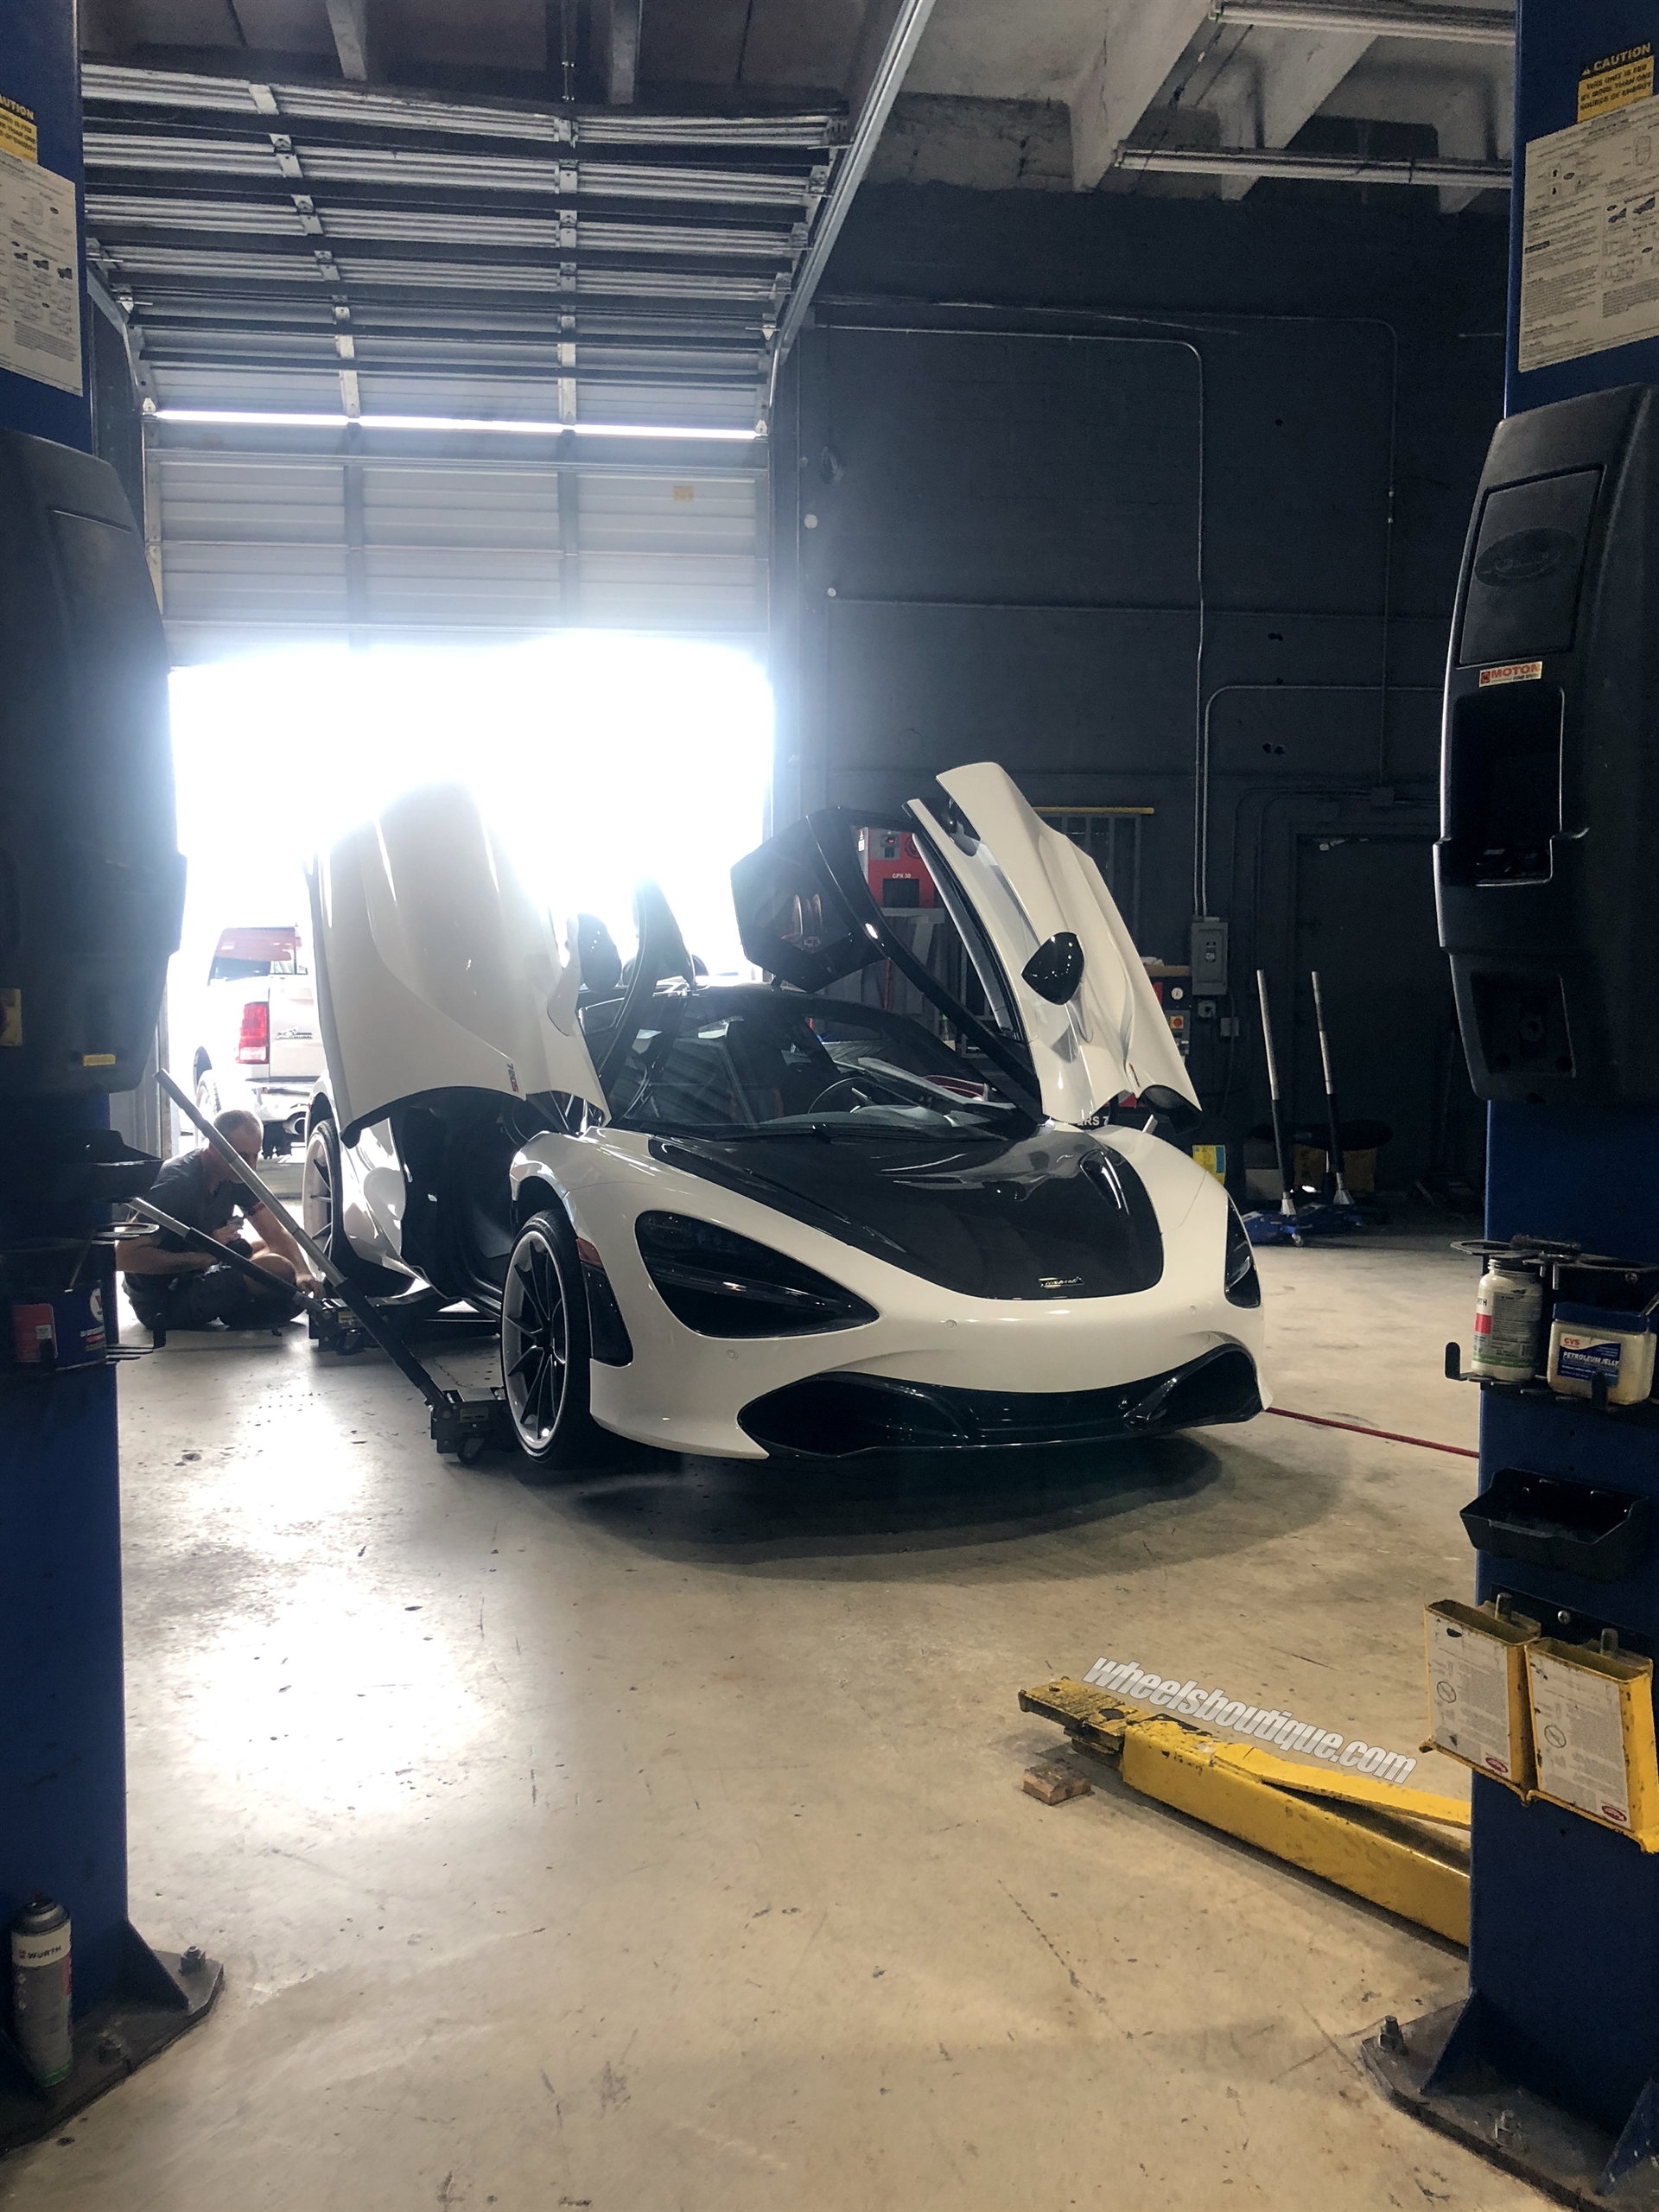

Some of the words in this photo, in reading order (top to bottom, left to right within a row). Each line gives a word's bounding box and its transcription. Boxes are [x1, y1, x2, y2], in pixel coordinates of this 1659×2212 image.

[1593, 41, 1651, 72] CAUTION
[1564, 1338, 1580, 1346] CVS
[1562, 1351, 1602, 1363] PETROLEUM
[1601, 1358, 1620, 1368] JELLY
